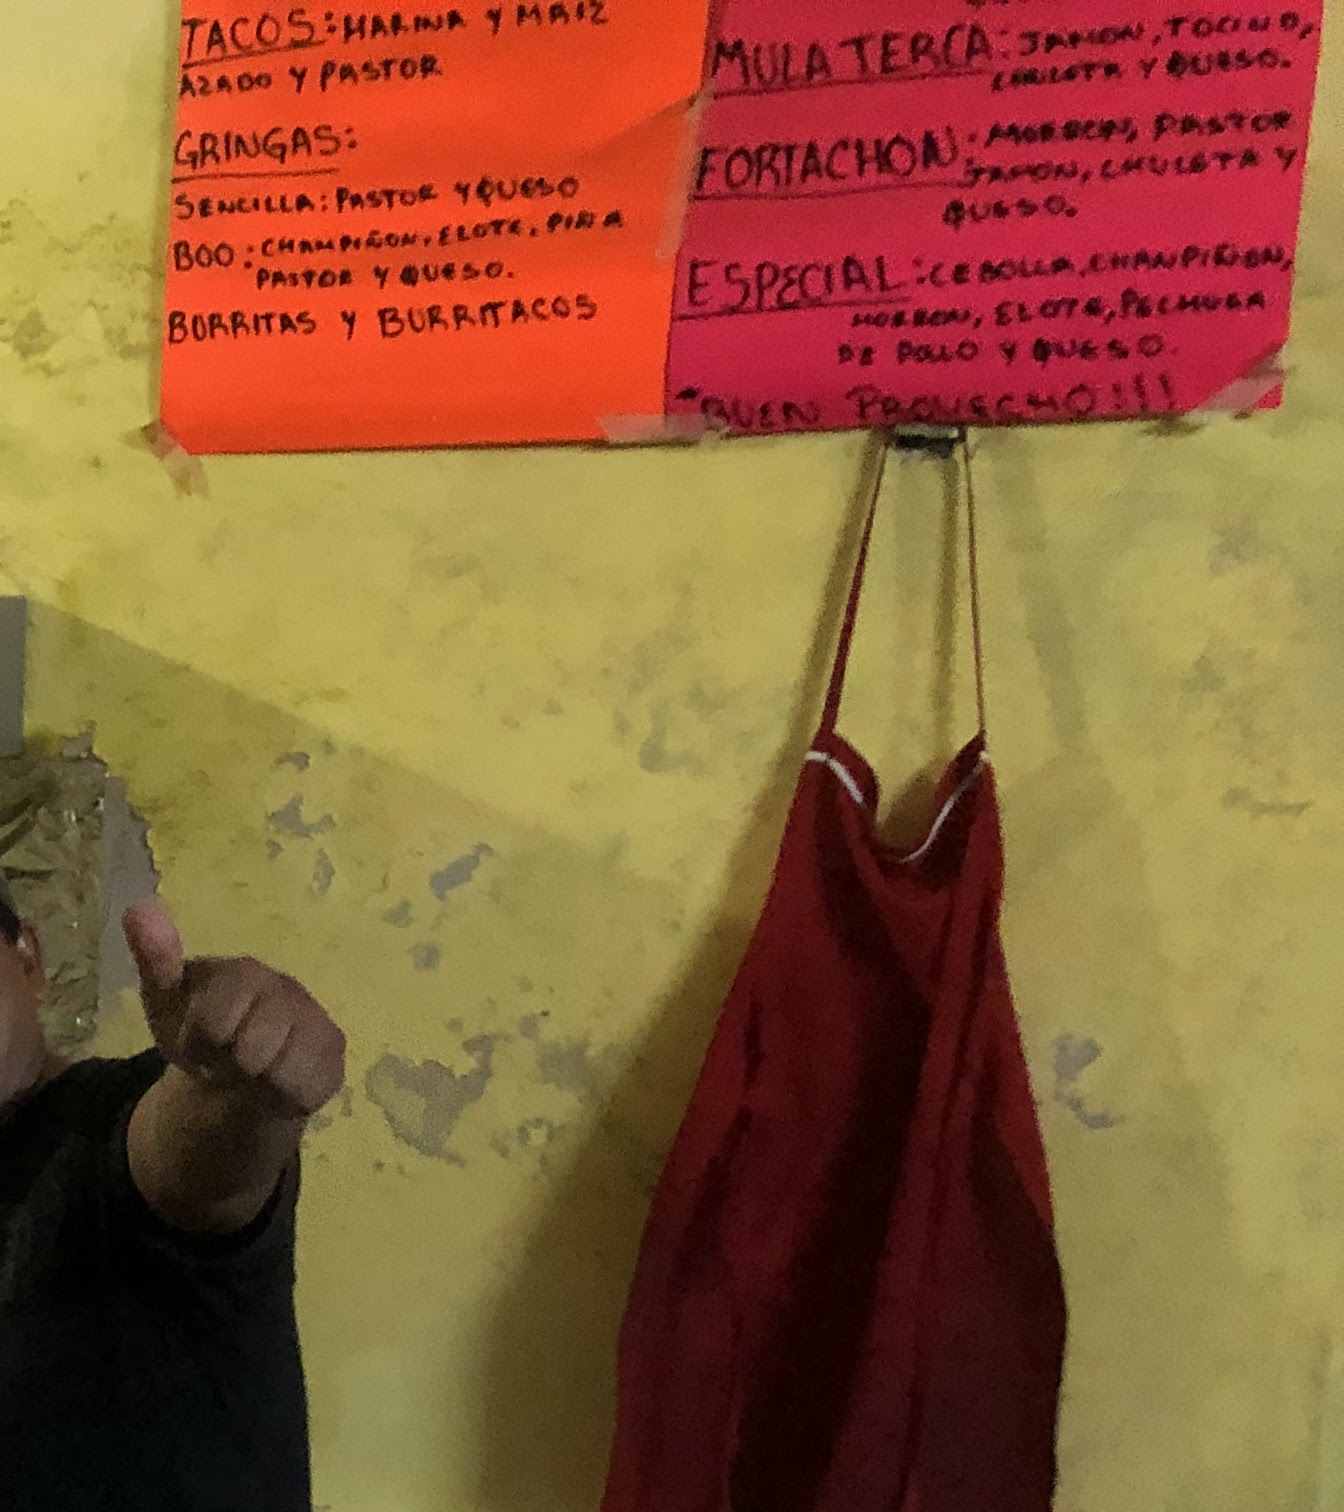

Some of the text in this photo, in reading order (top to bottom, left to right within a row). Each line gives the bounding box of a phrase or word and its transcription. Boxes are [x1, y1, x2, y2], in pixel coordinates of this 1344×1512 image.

[182, 0, 608, 60] TACOS: HARINA Y MAIZ
[288, 66, 308, 94] Y
[320, 54, 443, 92] PASTOR
[712, 38, 831, 86] MULA
[1138, 56, 1160, 79] Y
[1166, 48, 1292, 79] QUESO.
[1154, 109, 1293, 141] PASTOR
[174, 125, 358, 170] GRINGAS:
[1101, 148, 1260, 180] CHULETA
[1274, 146, 1298, 172] Y
[174, 192, 328, 221] SENCILLA:
[336, 182, 439, 213] PASTOR
[475, 175, 581, 208] QUESO
[943, 193, 1078, 229] QUESO.
[256, 260, 514, 290] PASTOR Y QUESO.
[168, 293, 598, 345] BURRITAS Y BURRITACOS
[837, 341, 875, 366] DE
[897, 339, 979, 364] POLLO
[999, 340, 1018, 365] Y
